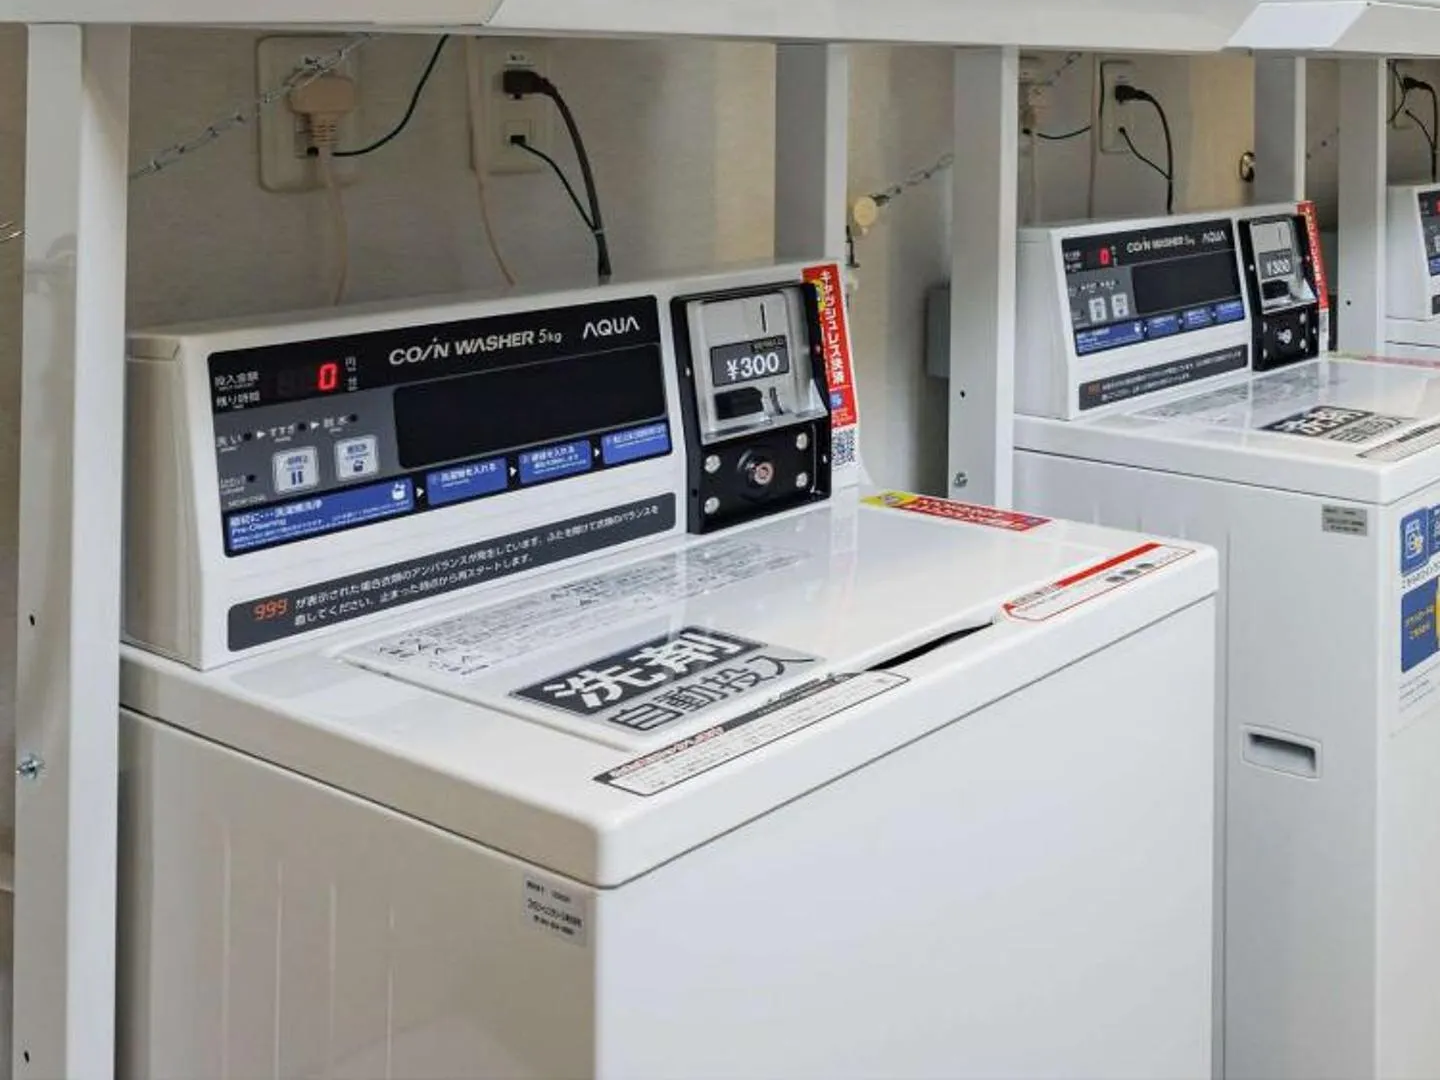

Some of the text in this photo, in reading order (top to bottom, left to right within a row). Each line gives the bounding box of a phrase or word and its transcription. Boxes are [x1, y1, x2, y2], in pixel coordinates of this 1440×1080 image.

[455, 329, 535, 356] WASHER
[538, 328, 563, 345] 5kg
[582, 315, 641, 340] AQUA
[215, 371, 260, 387] 投入金額
[318, 362, 338, 391] 0
[726, 351, 780, 381] ¥300
[215, 391, 261, 408] 残り時間
[254, 598, 289, 620] 999
[542, 630, 745, 709] 洗剤
[608, 655, 816, 732] 自動投入
